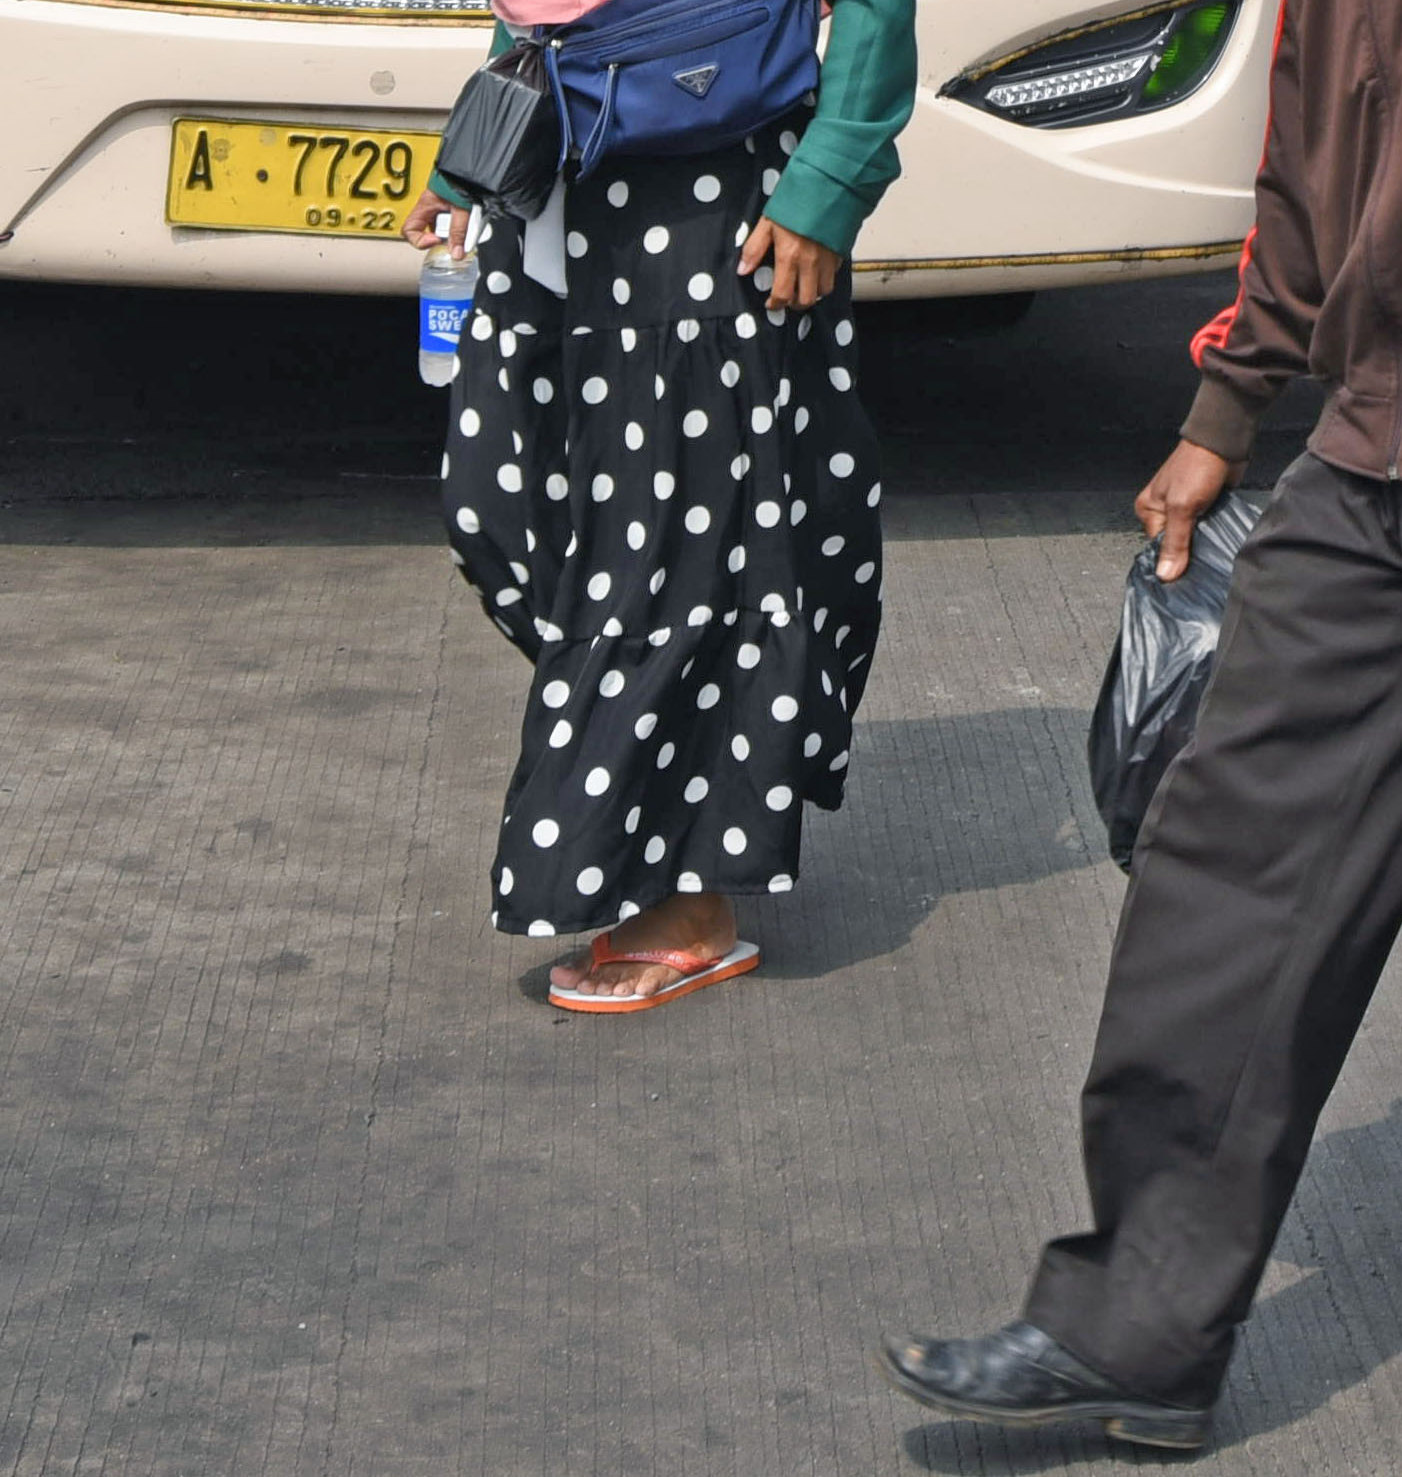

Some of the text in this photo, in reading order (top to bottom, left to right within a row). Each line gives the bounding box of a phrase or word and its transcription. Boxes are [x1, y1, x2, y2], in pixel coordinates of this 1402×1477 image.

[185, 130, 413, 201] A 7729
[428, 308, 469, 321] POCA
[428, 320, 462, 331] SWE
